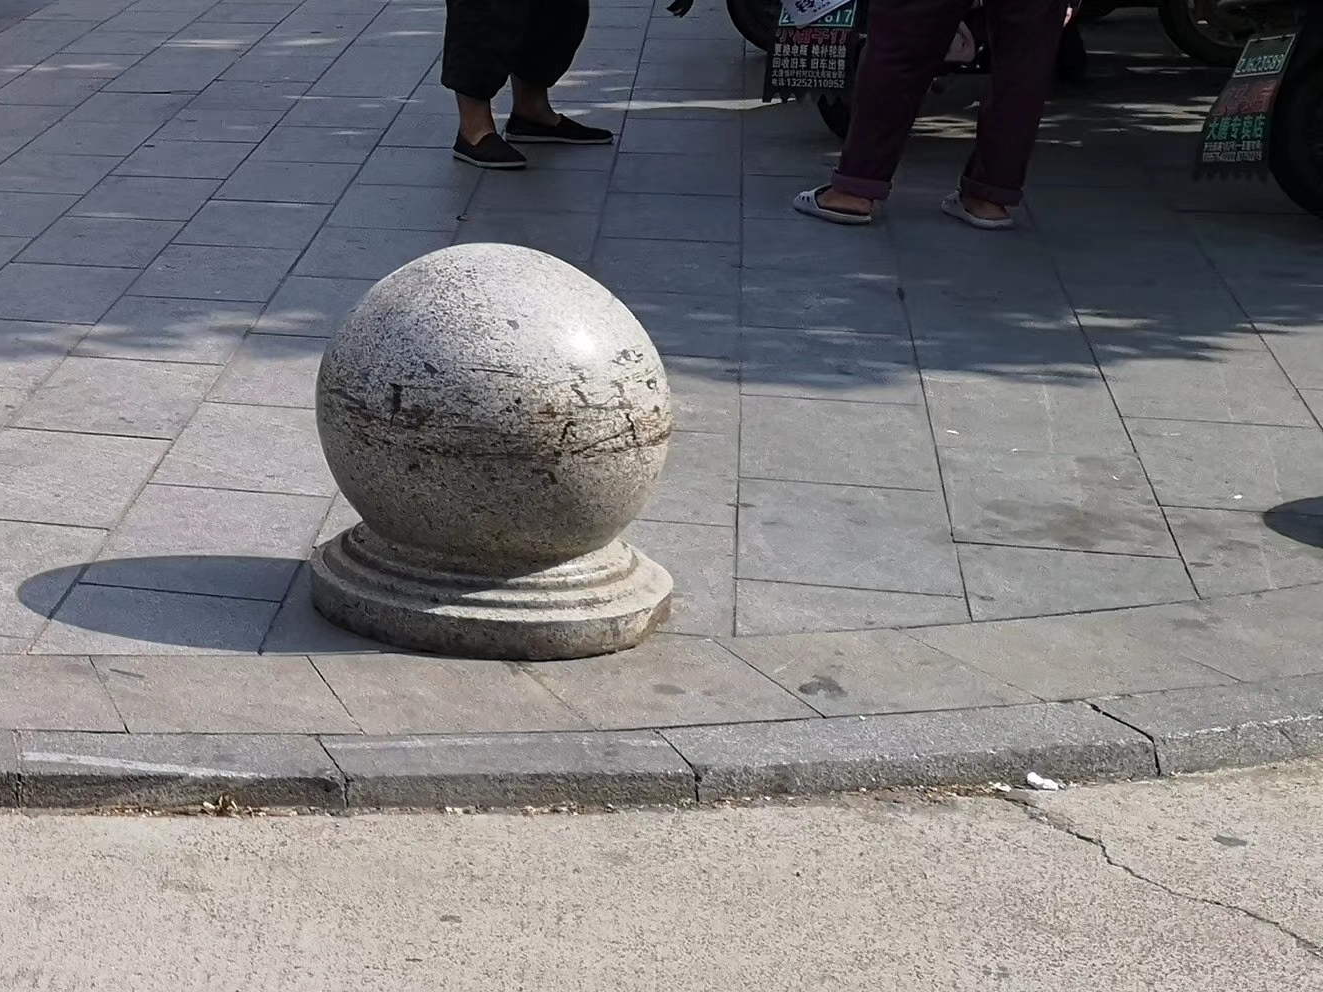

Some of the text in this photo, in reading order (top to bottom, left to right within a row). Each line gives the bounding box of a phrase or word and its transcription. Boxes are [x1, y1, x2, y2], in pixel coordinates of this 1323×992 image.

[772, 58, 846, 70] 回收旧车 旧车出售
